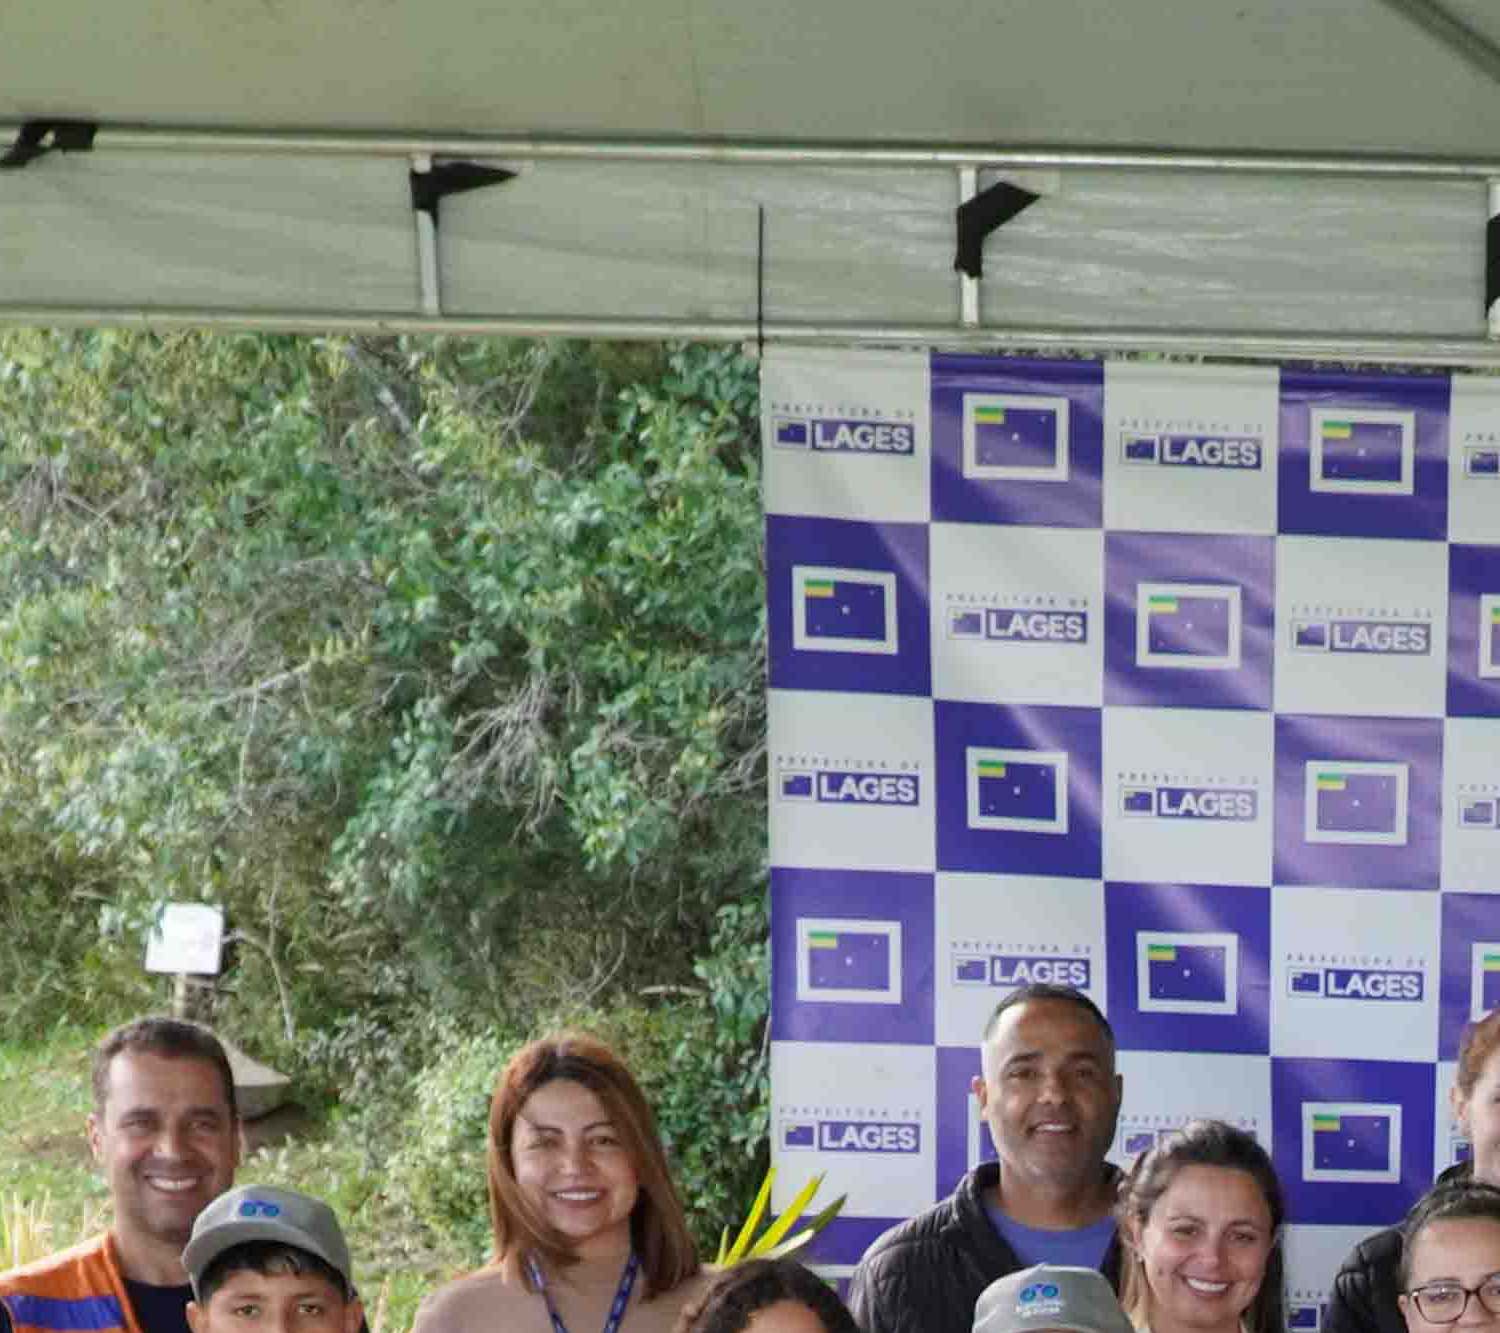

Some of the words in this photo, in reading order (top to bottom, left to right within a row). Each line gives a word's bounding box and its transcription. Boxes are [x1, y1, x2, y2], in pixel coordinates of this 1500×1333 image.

[815, 423, 910, 451] LAGES
[1164, 438, 1257, 465] LAGES
[990, 611, 1082, 639] LAGES
[1333, 624, 1426, 651] LAGES
[820, 774, 916, 802] LAGES
[1161, 790, 1253, 817] LAGES
[994, 958, 1086, 985] LAGES
[1327, 972, 1419, 999] LAGES
[822, 1125, 916, 1150] LAGES
